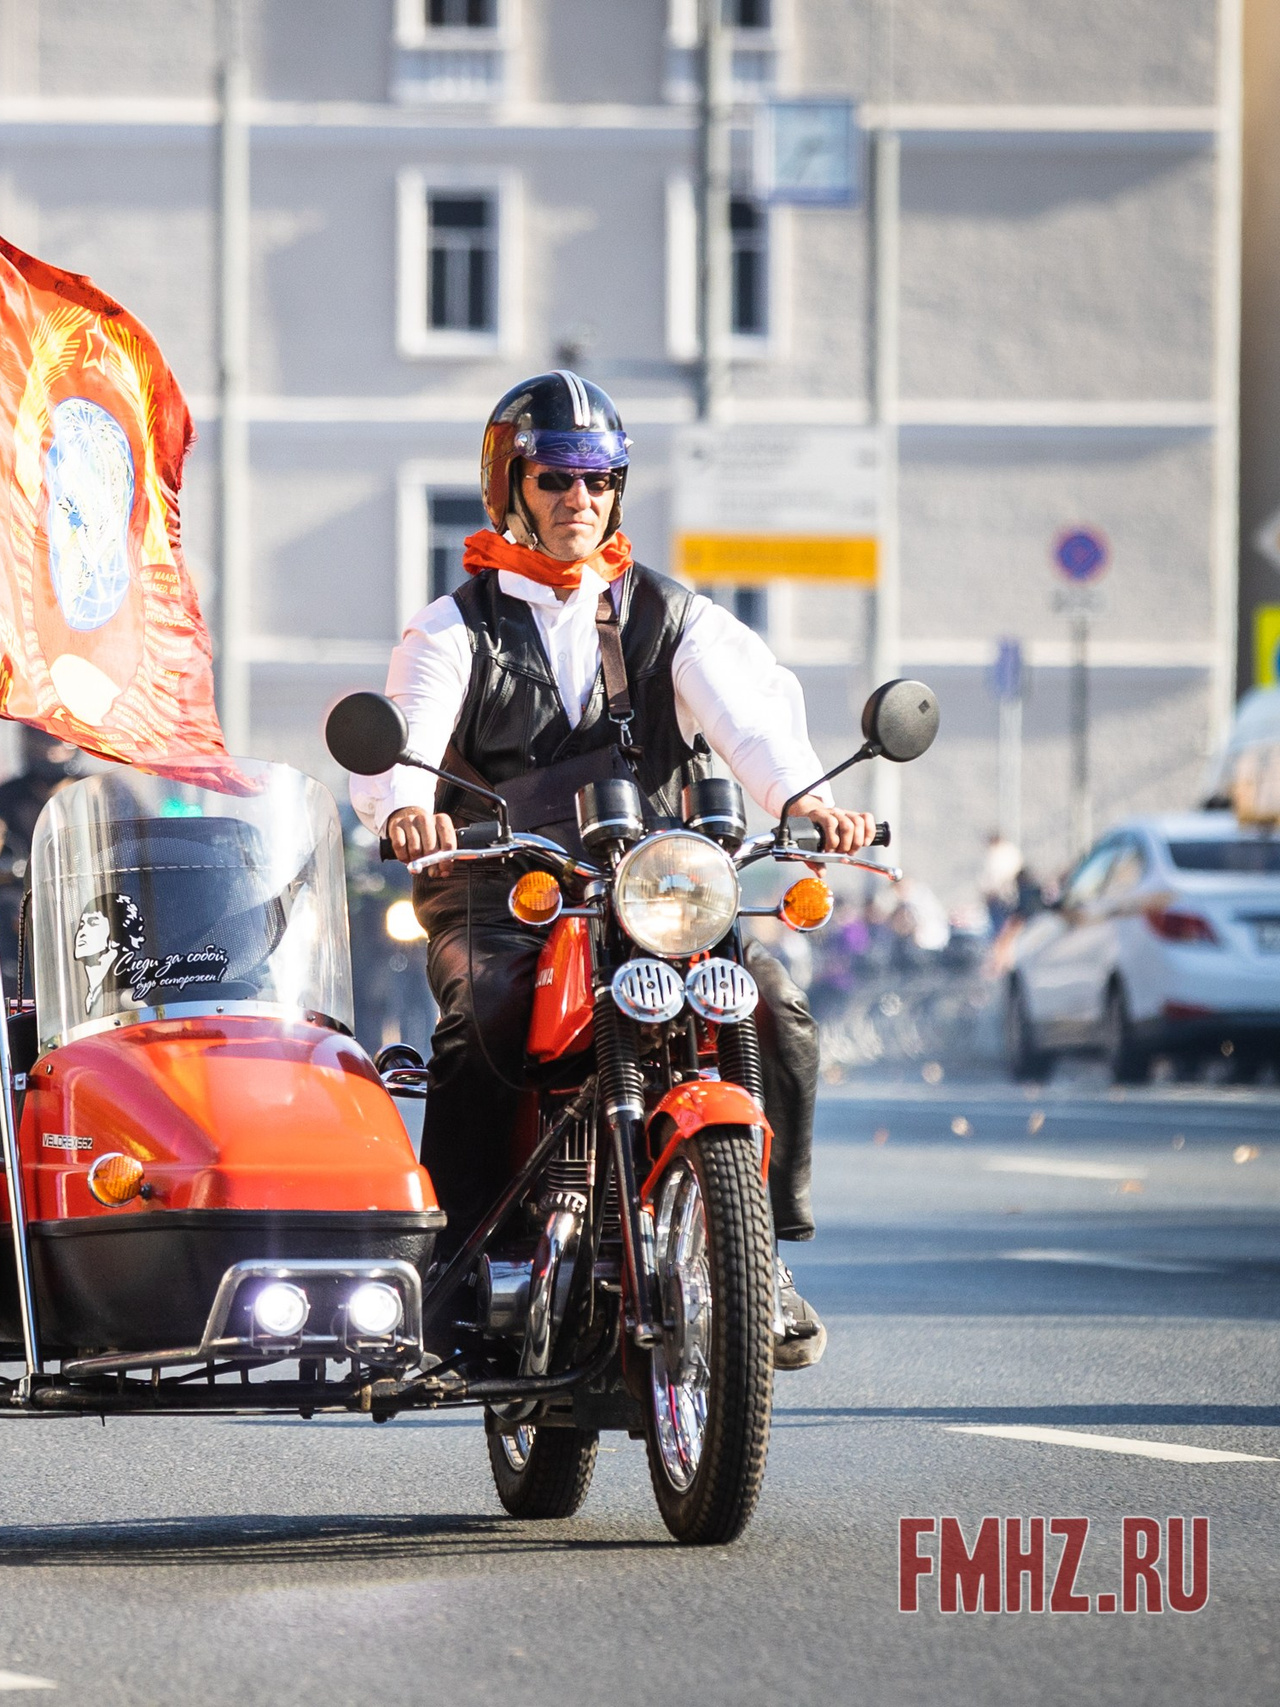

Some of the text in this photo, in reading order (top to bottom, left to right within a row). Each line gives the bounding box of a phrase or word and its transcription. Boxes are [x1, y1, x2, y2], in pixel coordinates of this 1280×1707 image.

[114, 944, 228, 985] Следи за собой,
[133, 967, 226, 999] будь осторожен!
